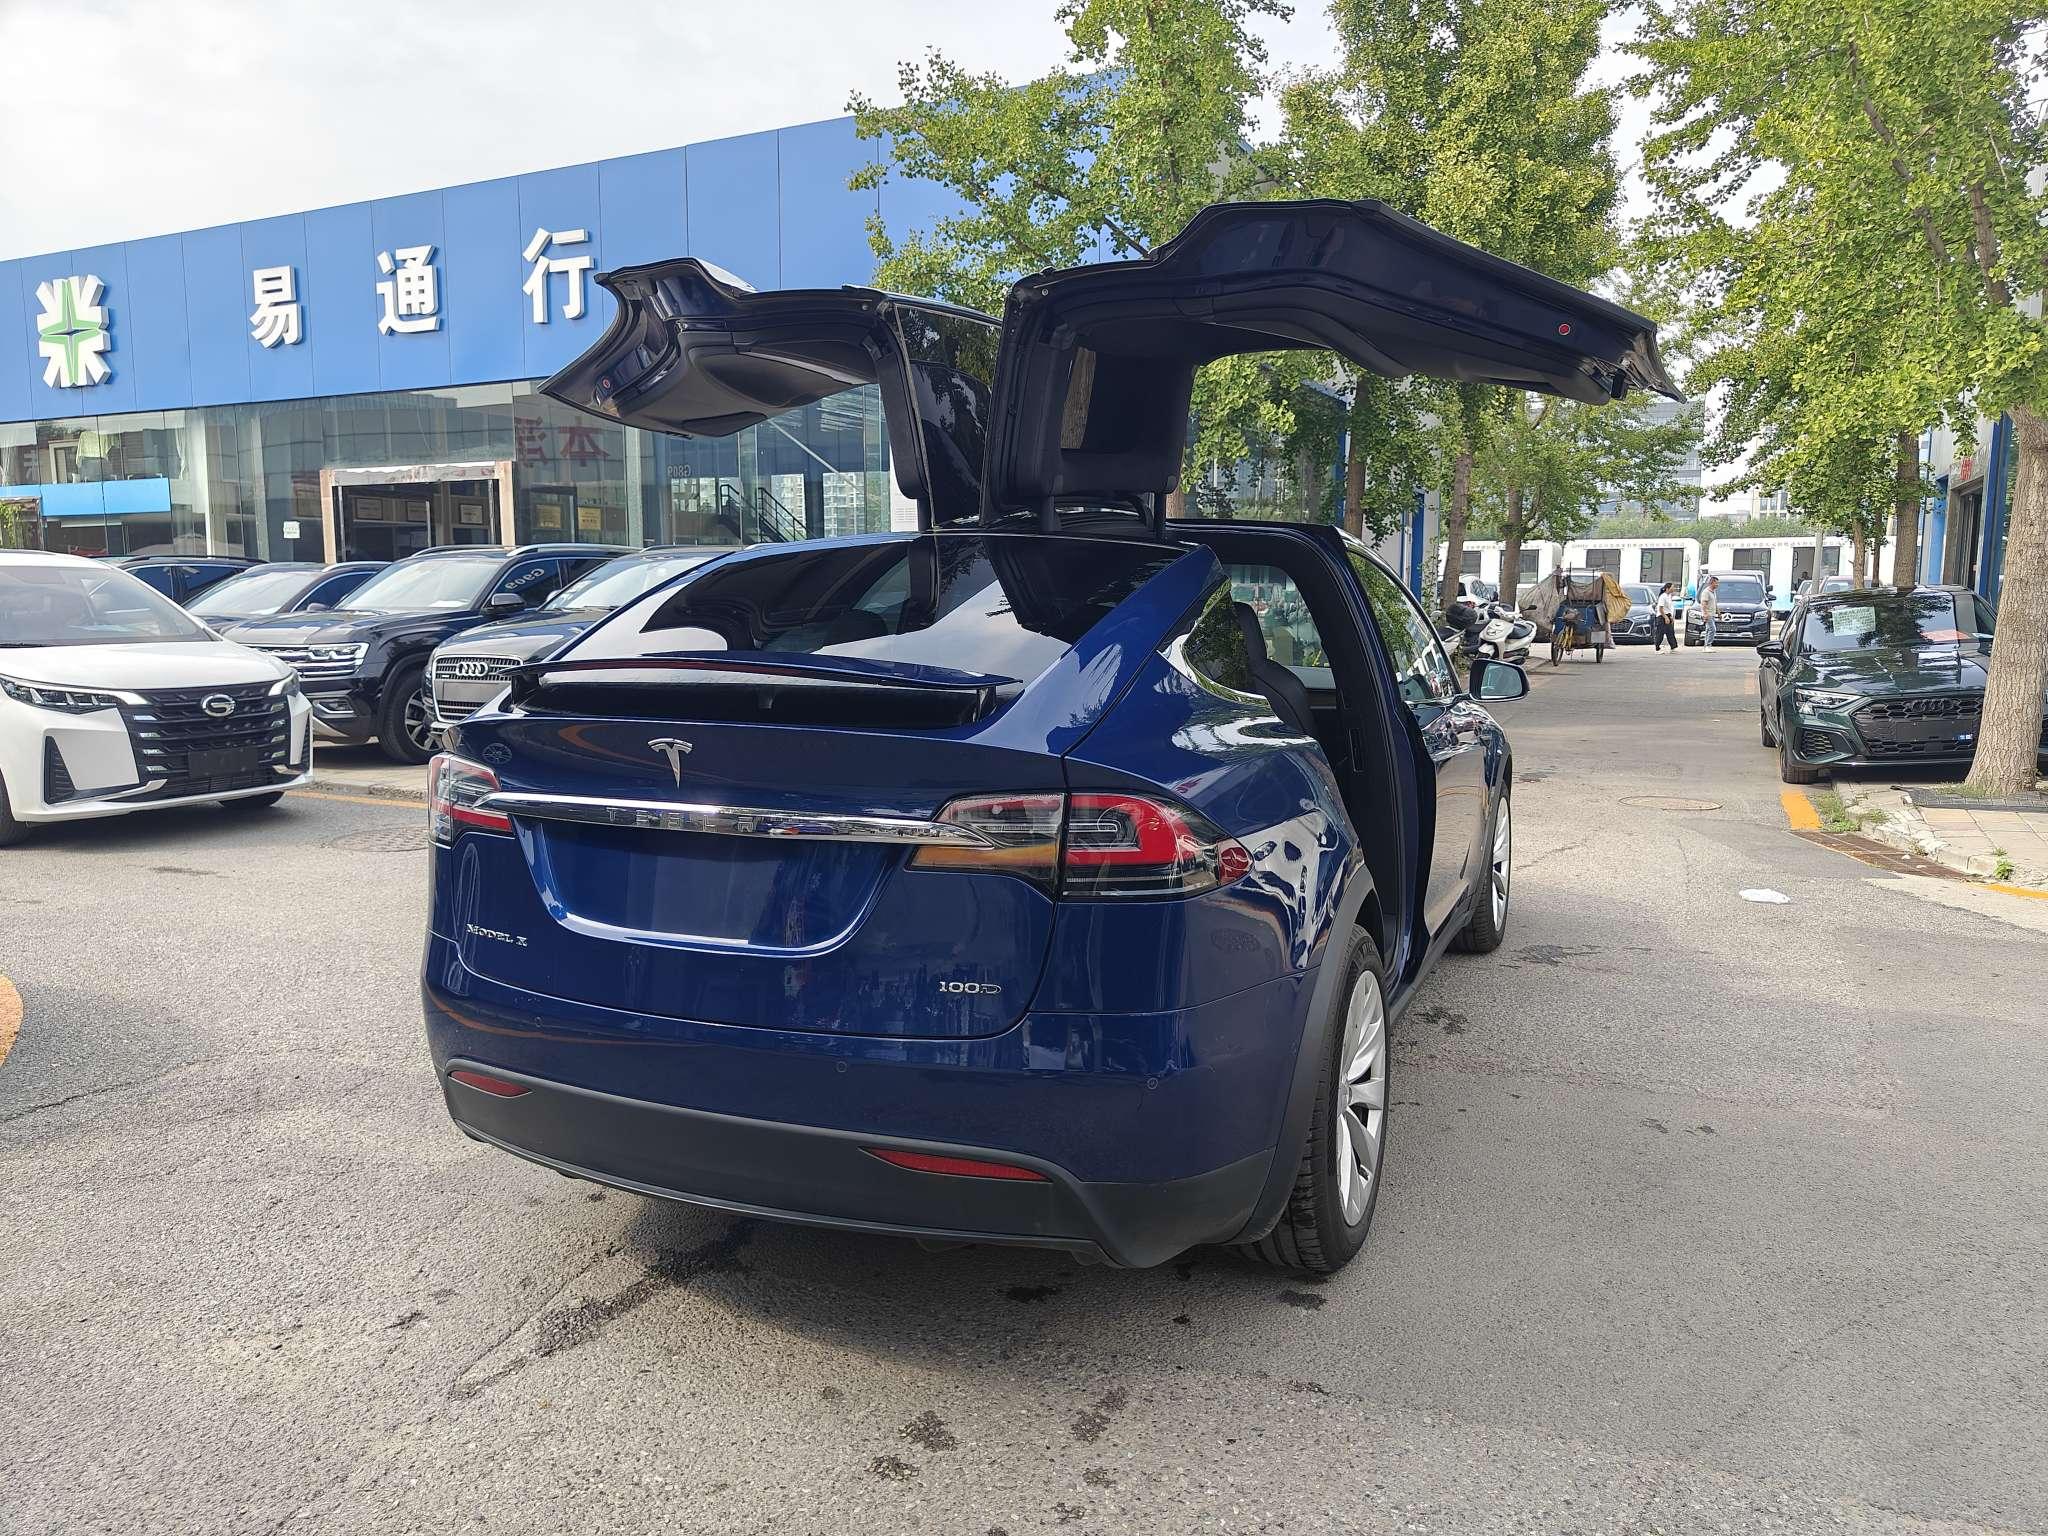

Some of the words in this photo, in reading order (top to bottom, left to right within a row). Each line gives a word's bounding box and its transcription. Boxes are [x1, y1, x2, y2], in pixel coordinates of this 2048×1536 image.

[250, 227, 595, 350] 易通行
[465, 923, 514, 944] MODEL
[516, 935, 528, 947] X
[939, 981, 1002, 994] 100D
